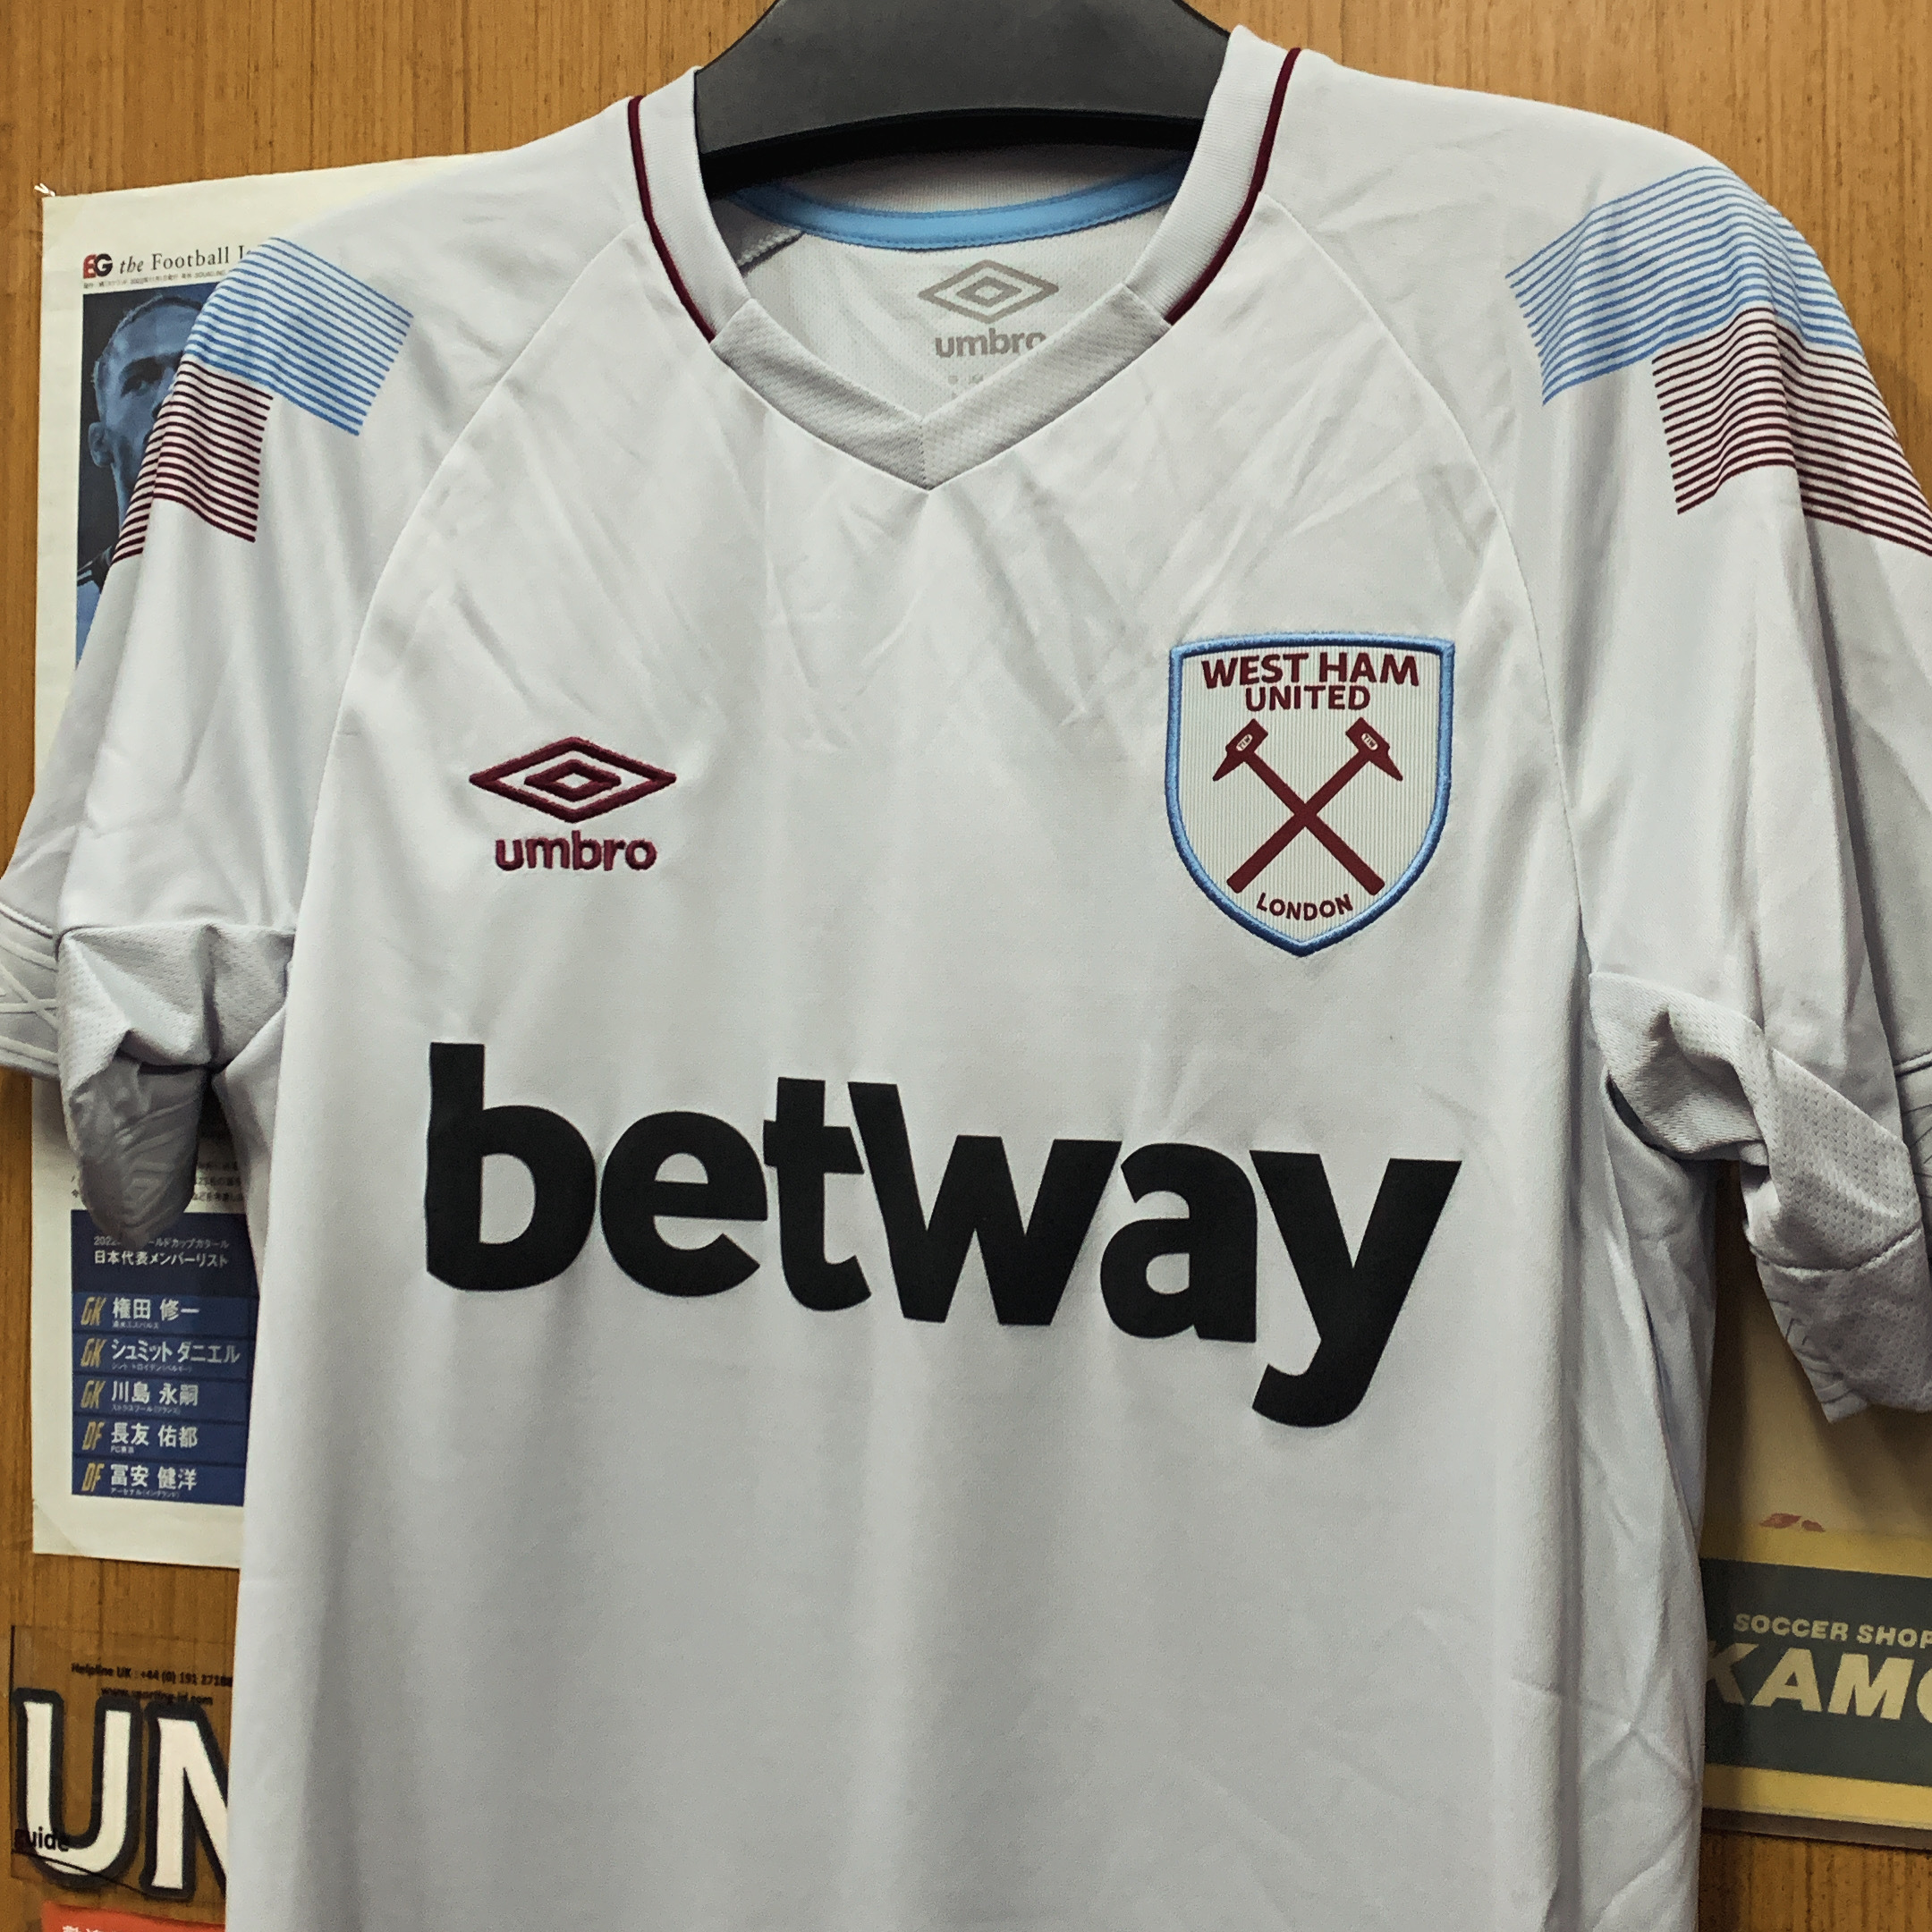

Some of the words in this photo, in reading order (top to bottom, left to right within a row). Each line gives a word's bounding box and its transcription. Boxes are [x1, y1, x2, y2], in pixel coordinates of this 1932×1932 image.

[120, 256, 144, 275] the
[151, 246, 230, 271] Football
[935, 327, 1047, 359] umbro
[1201, 652, 1309, 690] WEST
[1318, 651, 1419, 687] HAM
[1245, 684, 1371, 712] UNITED
[495, 829, 658, 872] umbro
[1256, 892, 1354, 921] LONDON
[425, 1041, 1463, 1429] betway
[94, 1250, 228, 1268] 日本代表メンバーリスト
[113, 1297, 151, 1320] 権田
[159, 1298, 199, 1321] 修一
[111, 1339, 173, 1362] シュミット
[177, 1342, 241, 1364] ダニエル
[111, 1381, 150, 1404] 川島
[111, 1422, 149, 1445] 長友
[157, 1425, 198, 1448] 佑都
[1733, 1613, 1848, 1642] SOCCER
[1857, 1623, 1932, 1649] SHOP
[71, 1662, 115, 1678] Helpline
[117, 1666, 131, 1680] UK
[179, 1674, 199, 1687] 191
[1706, 1640, 1932, 1724] KAM
